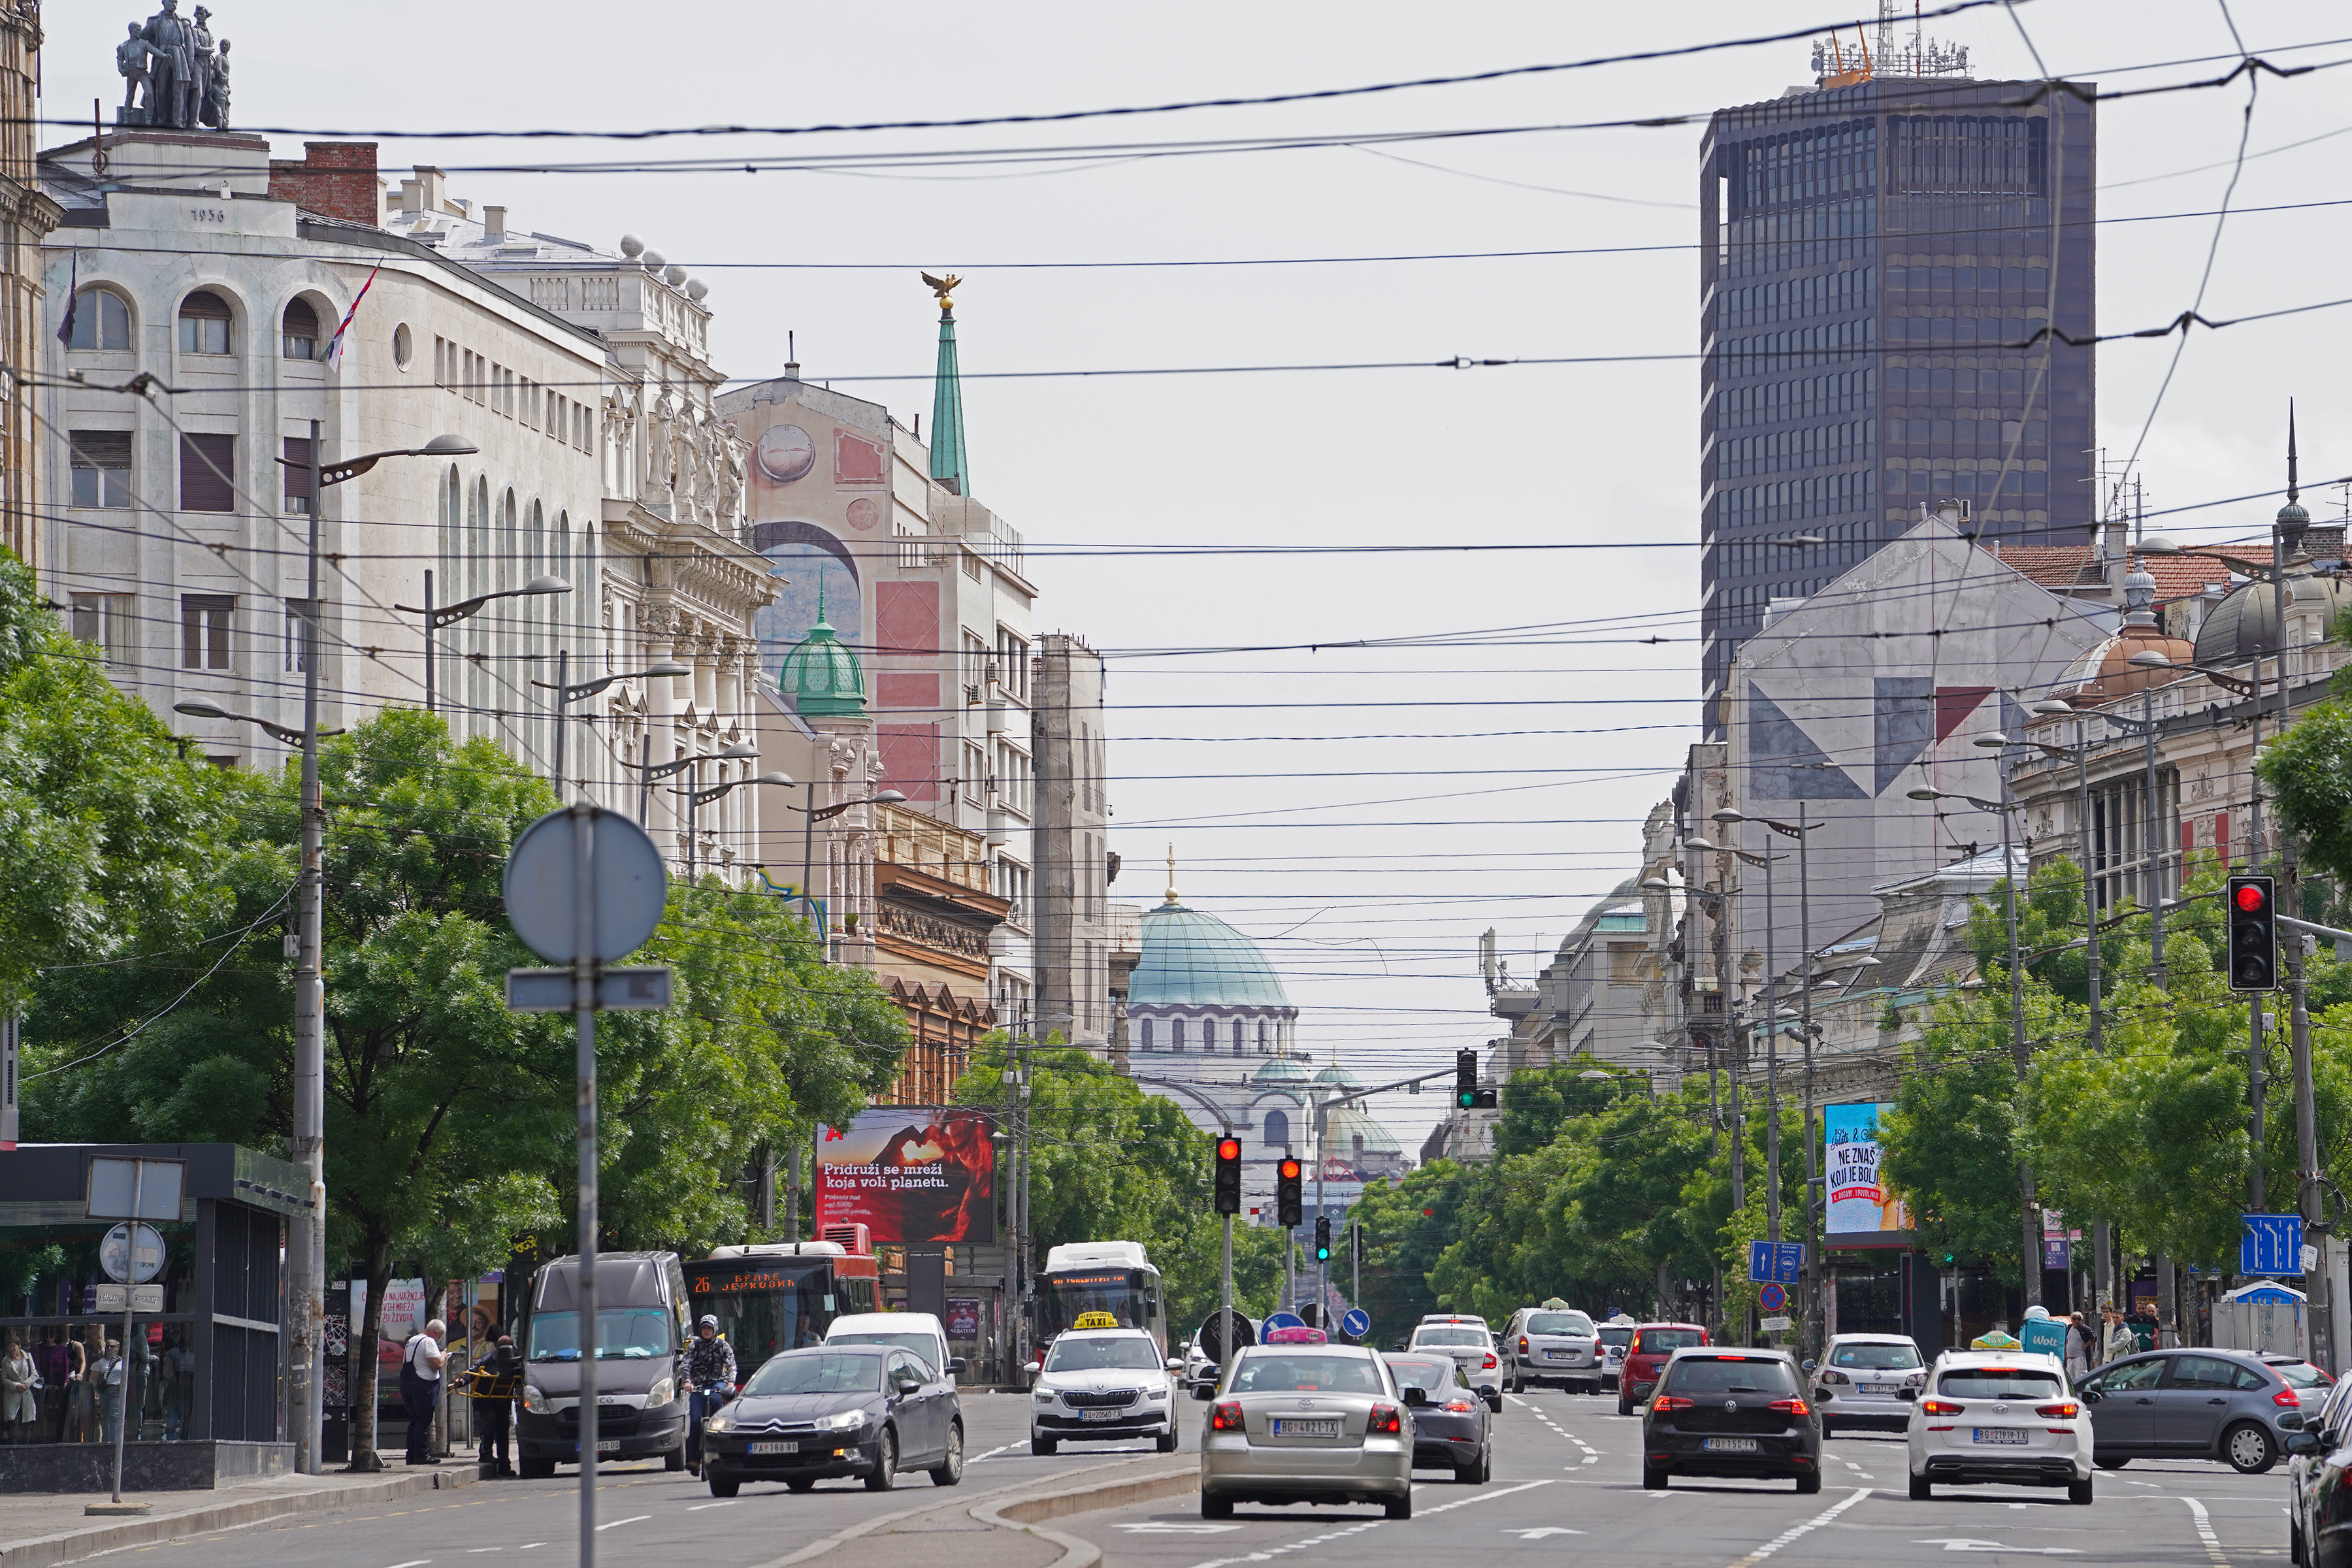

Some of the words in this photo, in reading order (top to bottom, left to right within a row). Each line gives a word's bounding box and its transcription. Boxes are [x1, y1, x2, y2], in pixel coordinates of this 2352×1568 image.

[191, 208, 225, 222] 1936
[1831, 1132, 1849, 1151] Gelati
[1838, 1149, 1850, 1166] NE
[1852, 1146, 1875, 1166] ZNAŠ
[824, 1163, 879, 1175] Pridruži
[883, 1166, 899, 1175] se
[904, 1163, 943, 1175] mreži
[826, 1176, 856, 1190] koja
[860, 1176, 887, 1188] voli
[890, 1177, 949, 1190] planetu.
[1830, 1168, 1847, 1188] KOJI
[1849, 1166, 1856, 1183] JE
[696, 1277, 710, 1292] 26
[735, 1273, 779, 1282] БРАЋЕ
[722, 1279, 794, 1291] ЈЕРКОВИЋ
[396, 1301, 416, 1311] MREŽA.
[392, 1312, 415, 1322] ŽIVOTA.
[2033, 1335, 2058, 1347] Wolt
[1282, 1422, 1293, 1432] BG
[753, 1444, 763, 1452] PA
[1710, 1439, 1720, 1448] PO
